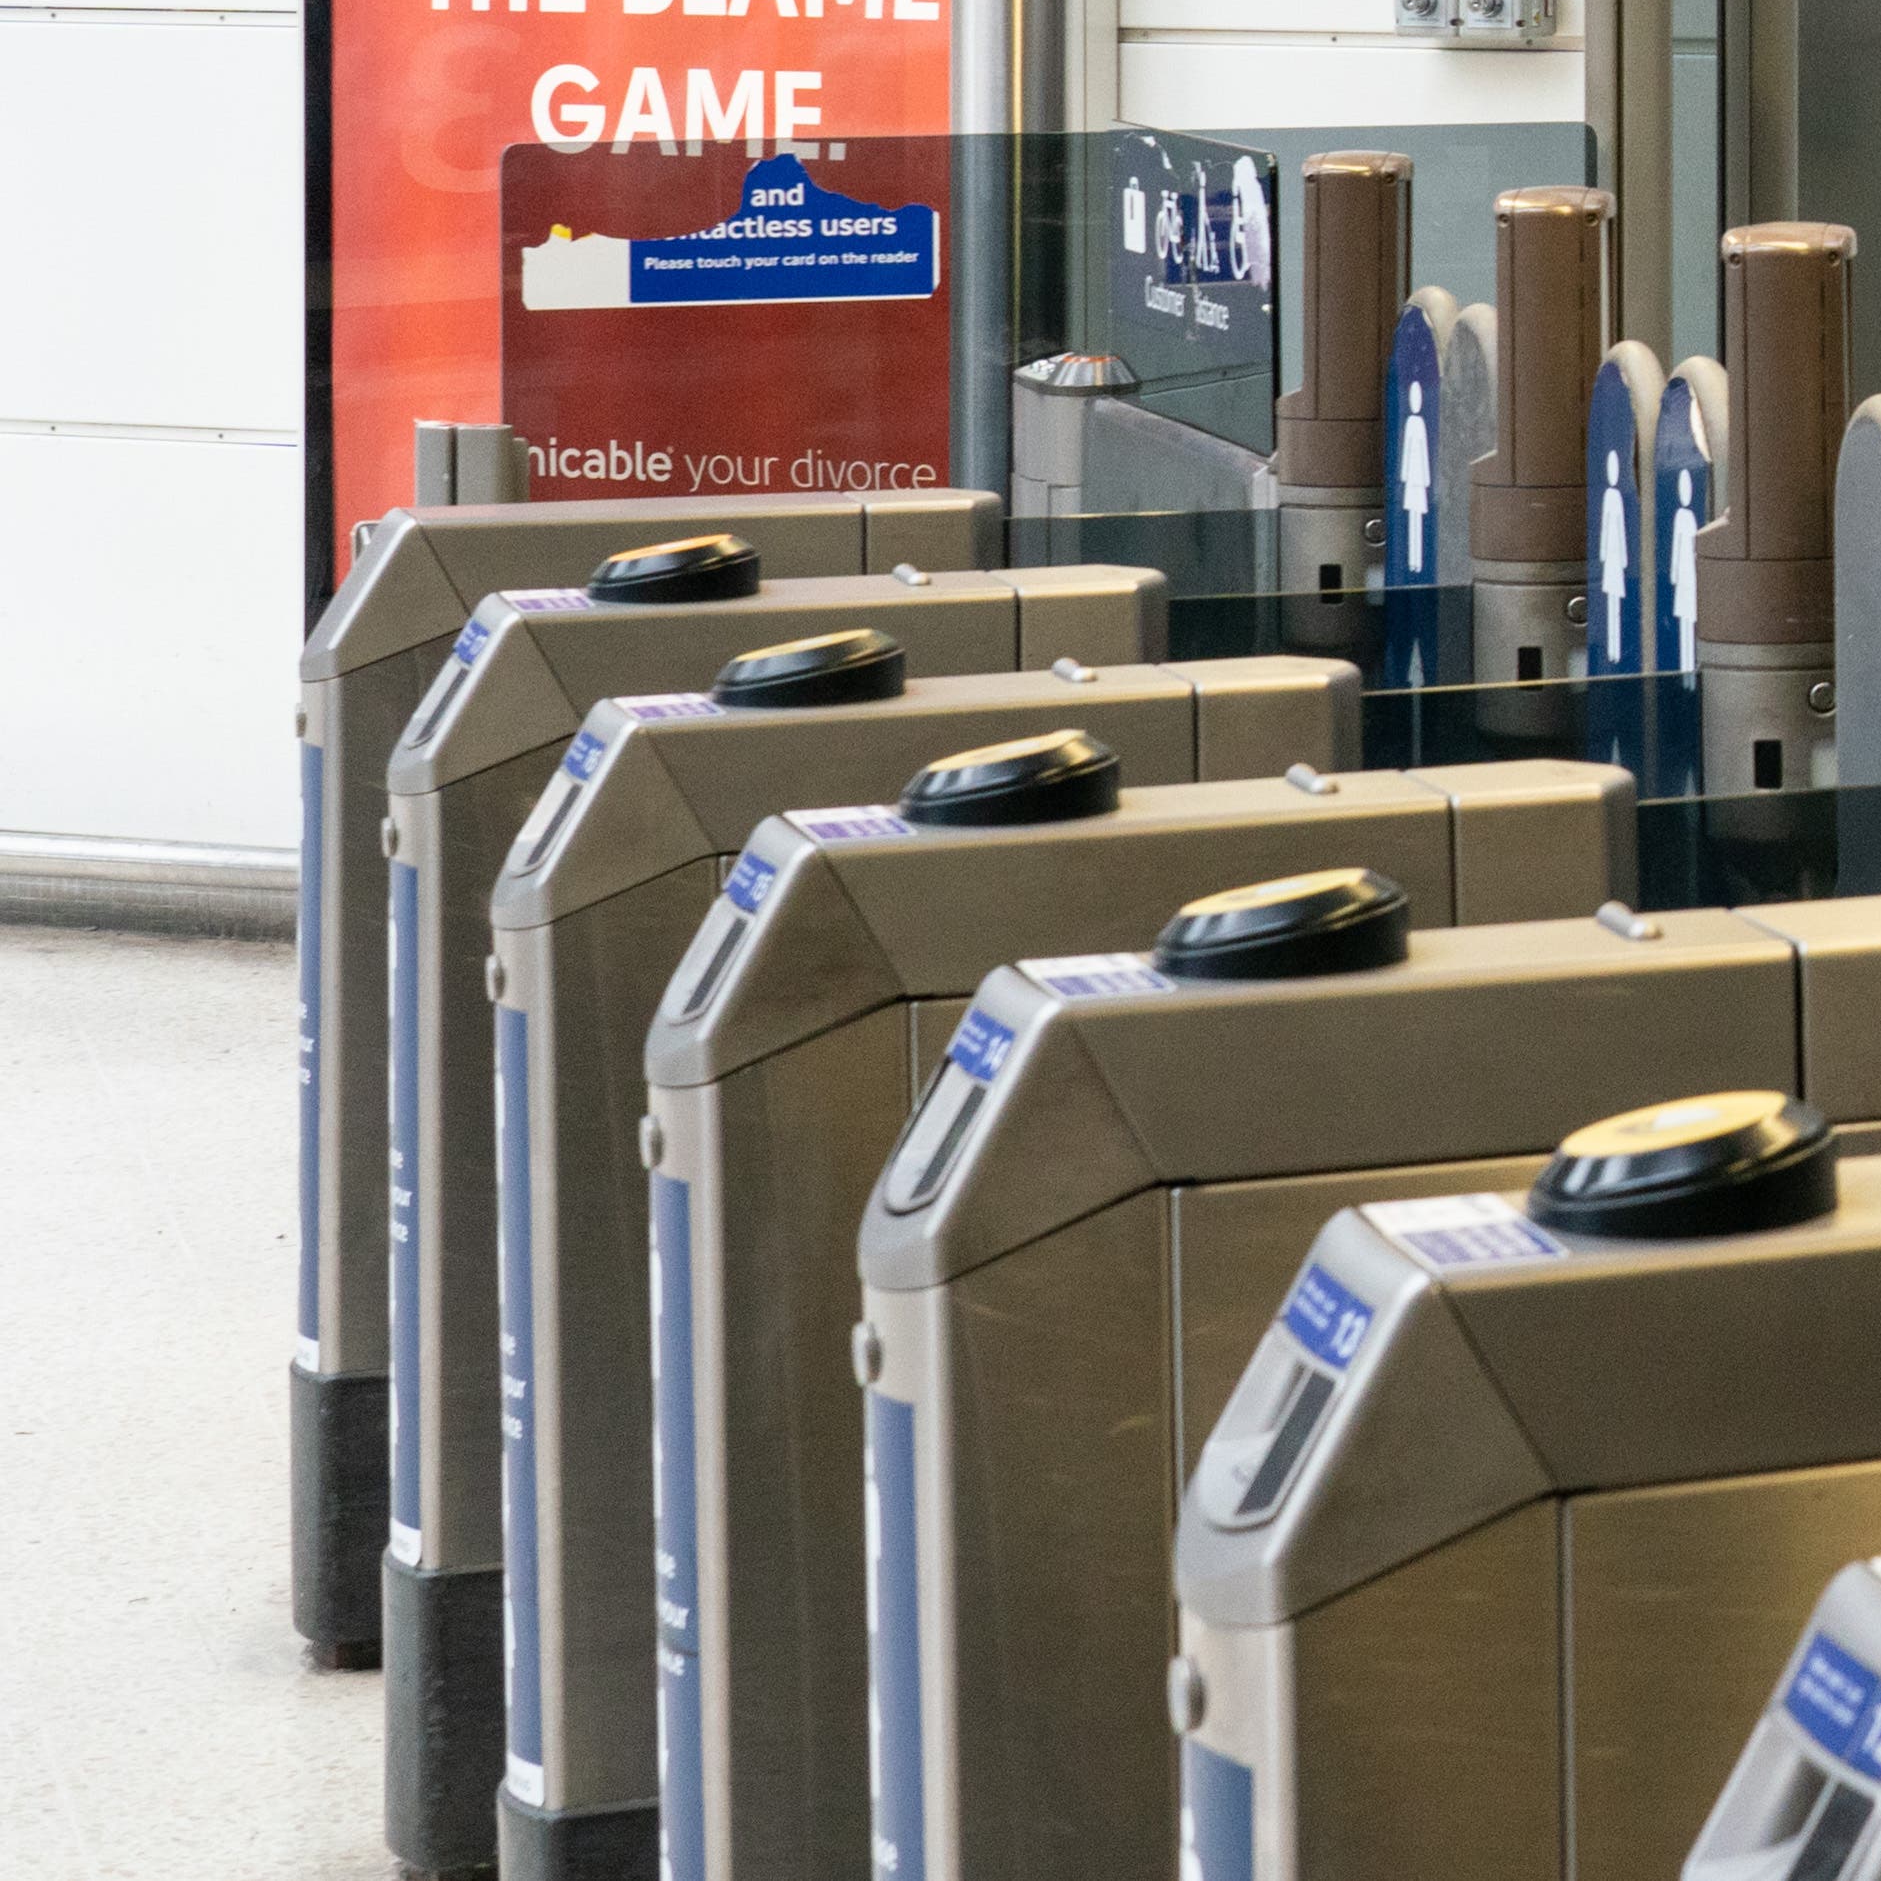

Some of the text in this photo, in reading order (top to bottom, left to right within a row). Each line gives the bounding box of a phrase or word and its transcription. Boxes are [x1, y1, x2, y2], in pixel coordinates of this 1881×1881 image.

[531, 64, 846, 161] GAME.
[750, 183, 804, 207] and
[820, 216, 897, 237] users
[645, 250, 919, 270] Please touch your card on the reader
[684, 454, 779, 492] your
[790, 449, 937, 491] divorce
[1330, 1309, 1368, 1359] 13
